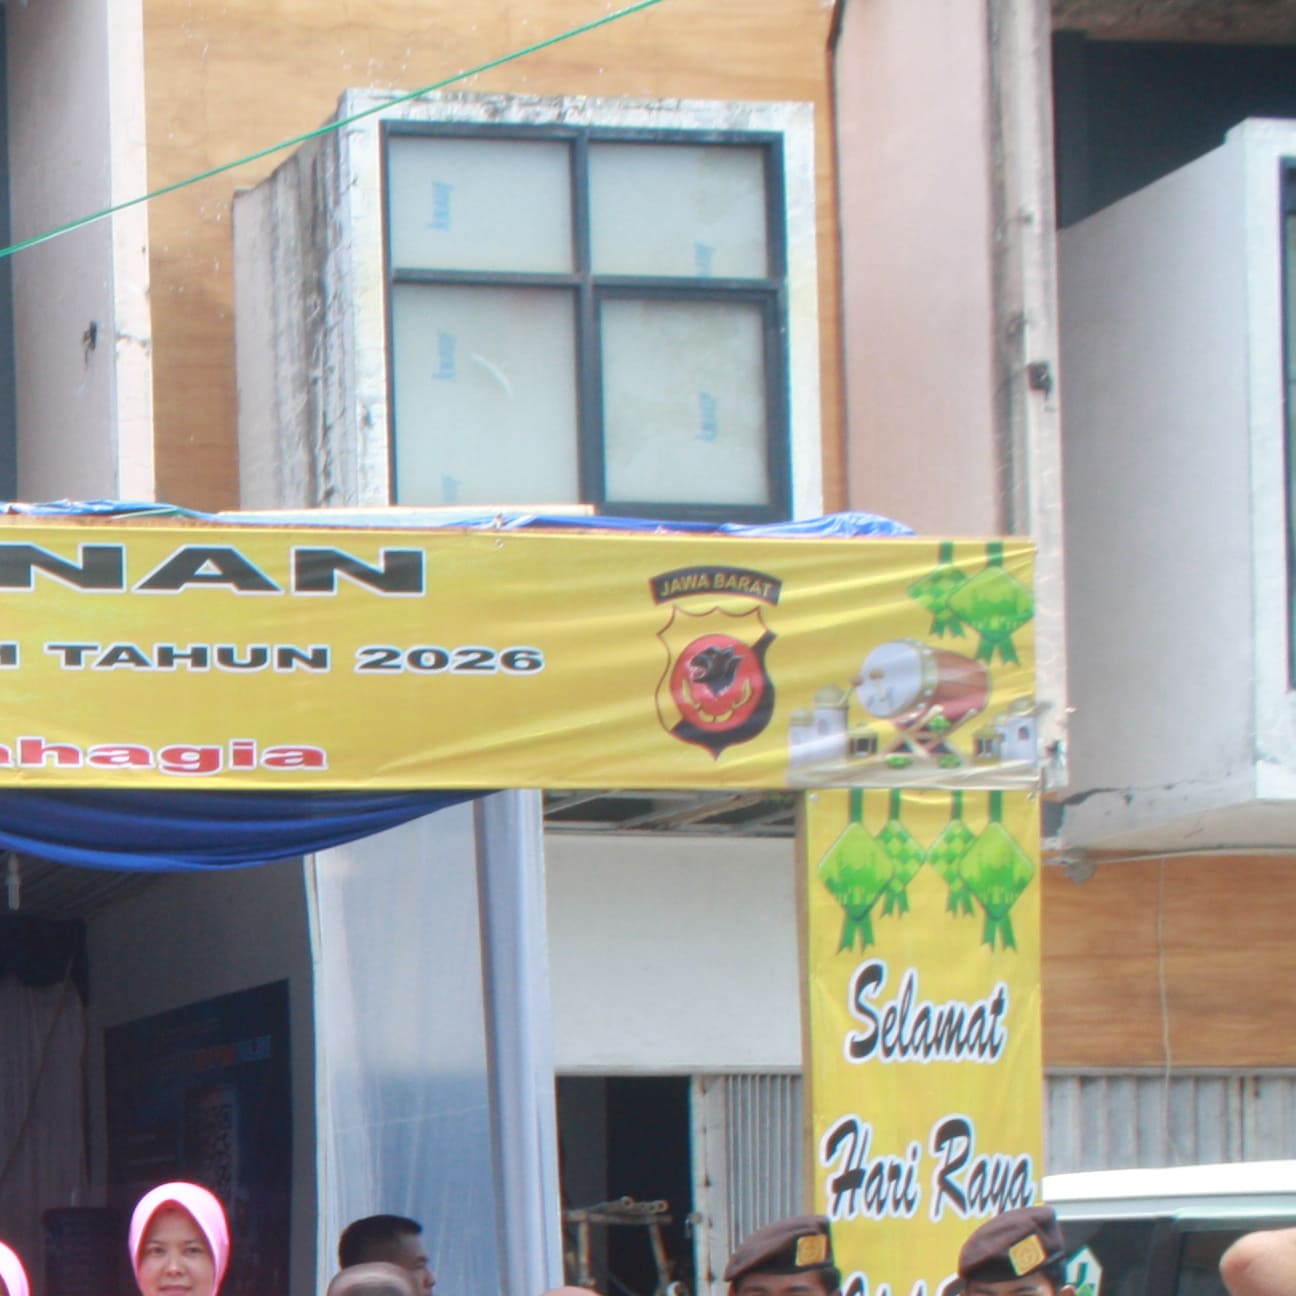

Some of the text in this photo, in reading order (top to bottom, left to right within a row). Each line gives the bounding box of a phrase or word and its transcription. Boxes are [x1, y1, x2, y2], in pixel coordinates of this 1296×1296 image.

[661, 573, 774, 598] JAWA BARAT
[46, 643, 330, 673] TAHUN
[354, 646, 545, 676] 2026
[848, 962, 1006, 1061] Selamat
[824, 1116, 1034, 1218] Hari Raya
